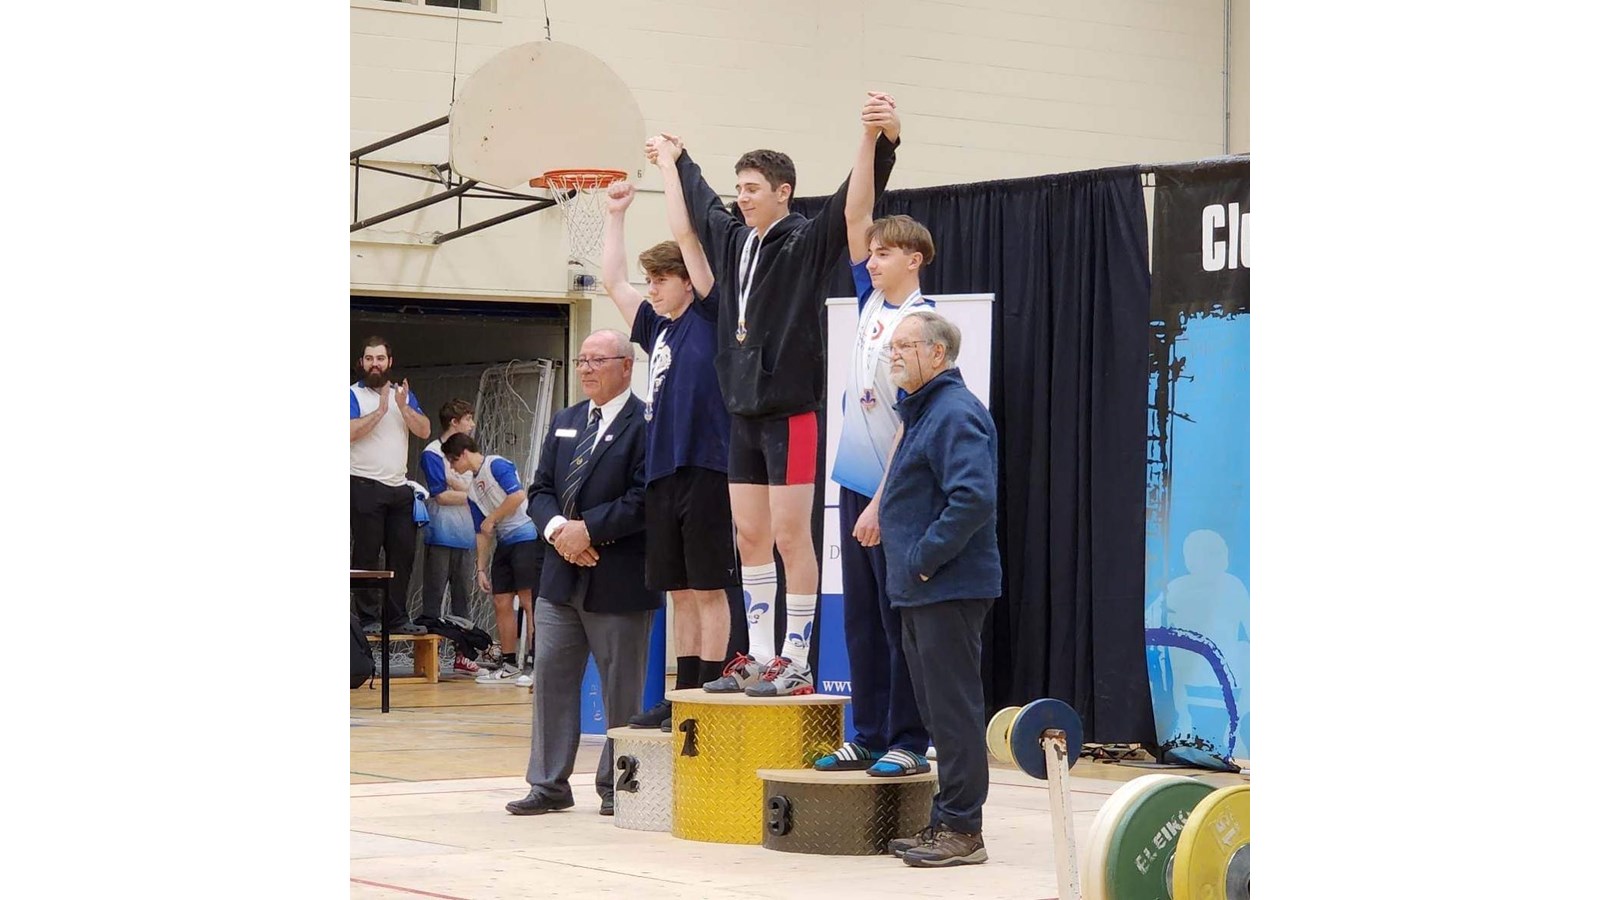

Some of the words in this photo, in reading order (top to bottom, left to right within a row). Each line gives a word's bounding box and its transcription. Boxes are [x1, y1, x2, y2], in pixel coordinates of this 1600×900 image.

[679, 718, 699, 757] 1
[616, 755, 639, 794] 2
[767, 795, 793, 837] 3
